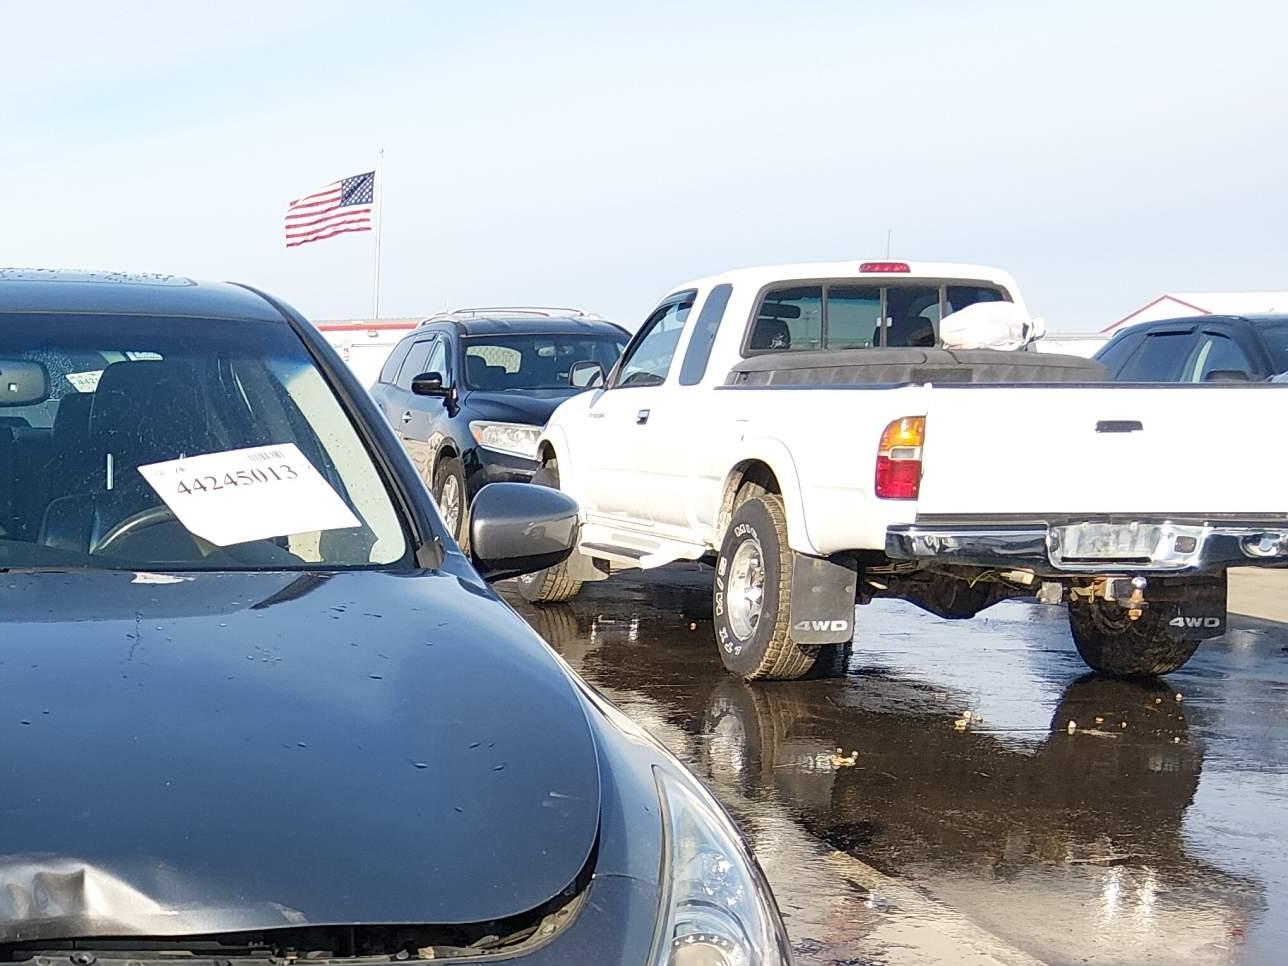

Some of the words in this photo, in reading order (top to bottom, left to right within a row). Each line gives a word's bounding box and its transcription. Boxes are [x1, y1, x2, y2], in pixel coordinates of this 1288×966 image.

[176, 463, 299, 496] 44245013
[793, 620, 848, 632] 4WD
[1168, 616, 1221, 628] 4WD
